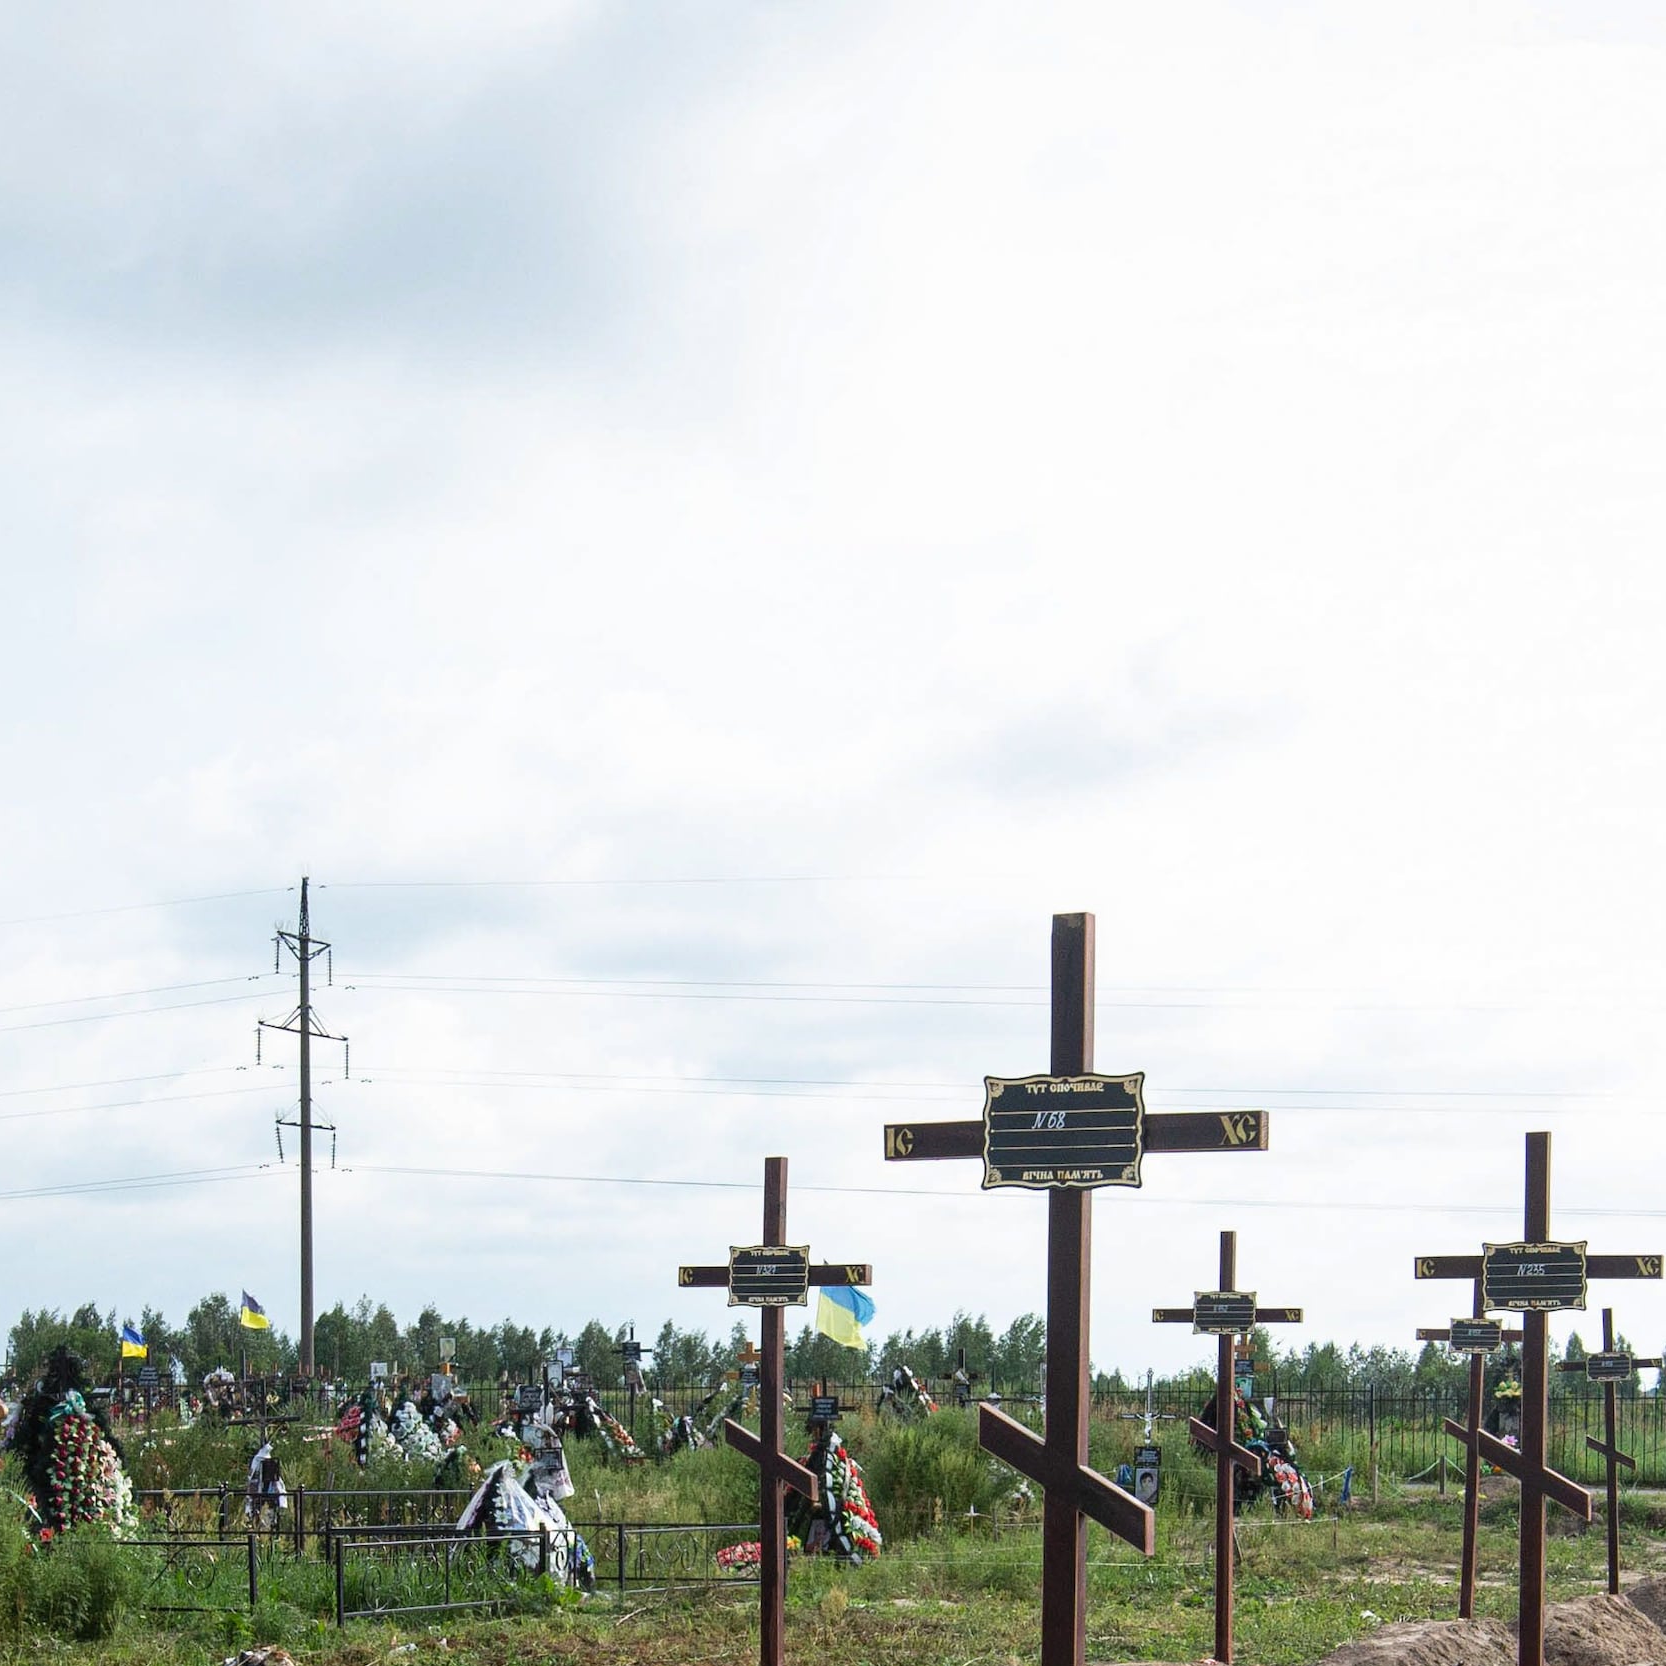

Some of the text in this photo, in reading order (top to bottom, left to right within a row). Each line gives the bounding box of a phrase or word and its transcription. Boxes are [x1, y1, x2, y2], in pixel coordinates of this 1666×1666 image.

[1025, 1083, 1048, 1095] ТУТ
[1031, 1111, 1066, 1130] N68
[1022, 1170, 1054, 1180] ВІЧНА
